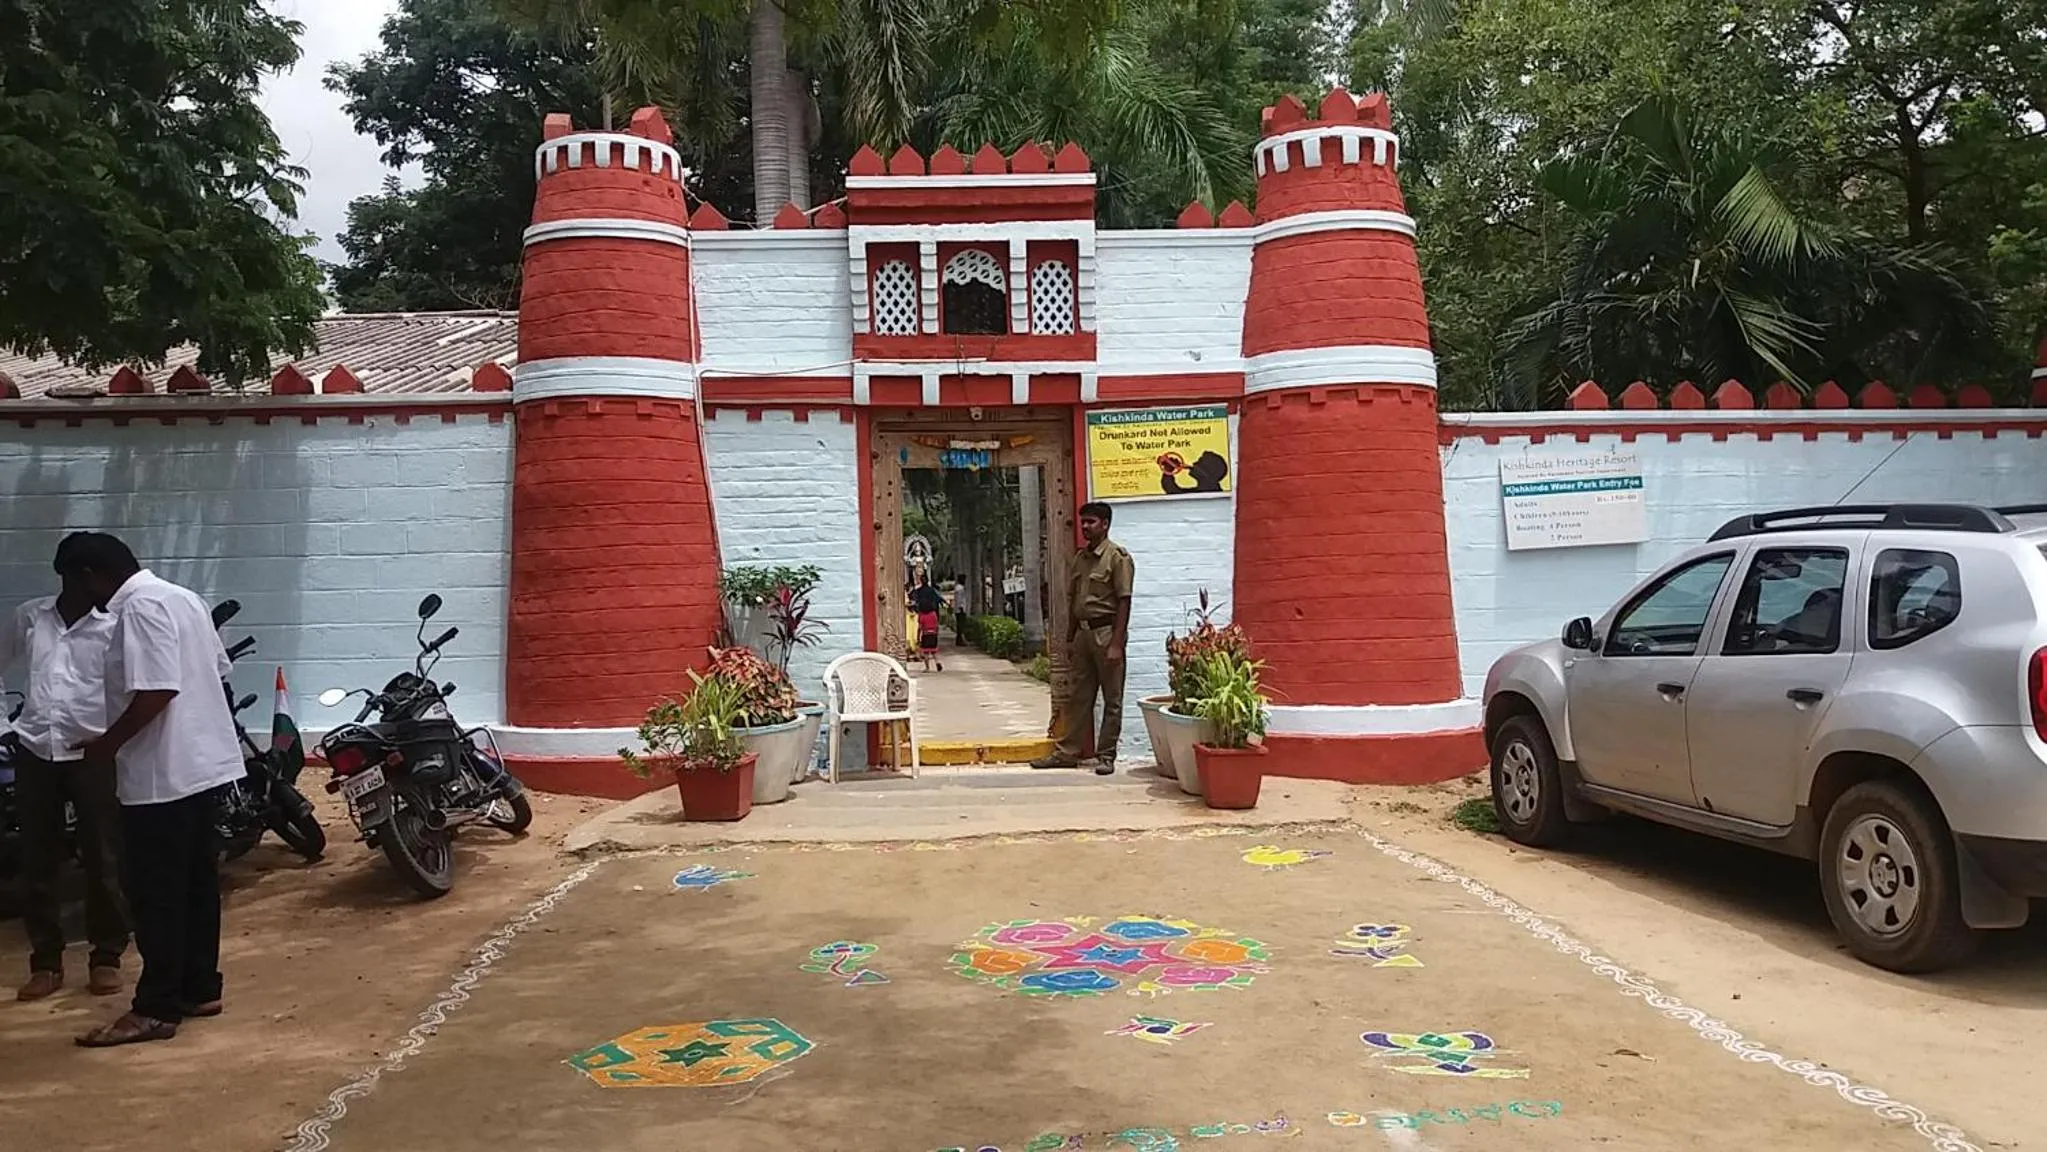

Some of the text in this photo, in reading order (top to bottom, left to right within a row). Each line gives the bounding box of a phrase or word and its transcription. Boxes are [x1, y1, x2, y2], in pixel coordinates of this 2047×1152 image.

[1100, 408, 1214, 423] Kishkinda Water Park
[1099, 429, 1147, 441] Drunkard
[1149, 428, 1168, 438] Not
[1170, 425, 1211, 437] Allowed
[1120, 438, 1191, 451] To Water Park
[1503, 454, 1636, 471] Kishkinda Heritage Resort
[1505, 478, 1640, 495] Kishkinda Water Park Entry Fee
